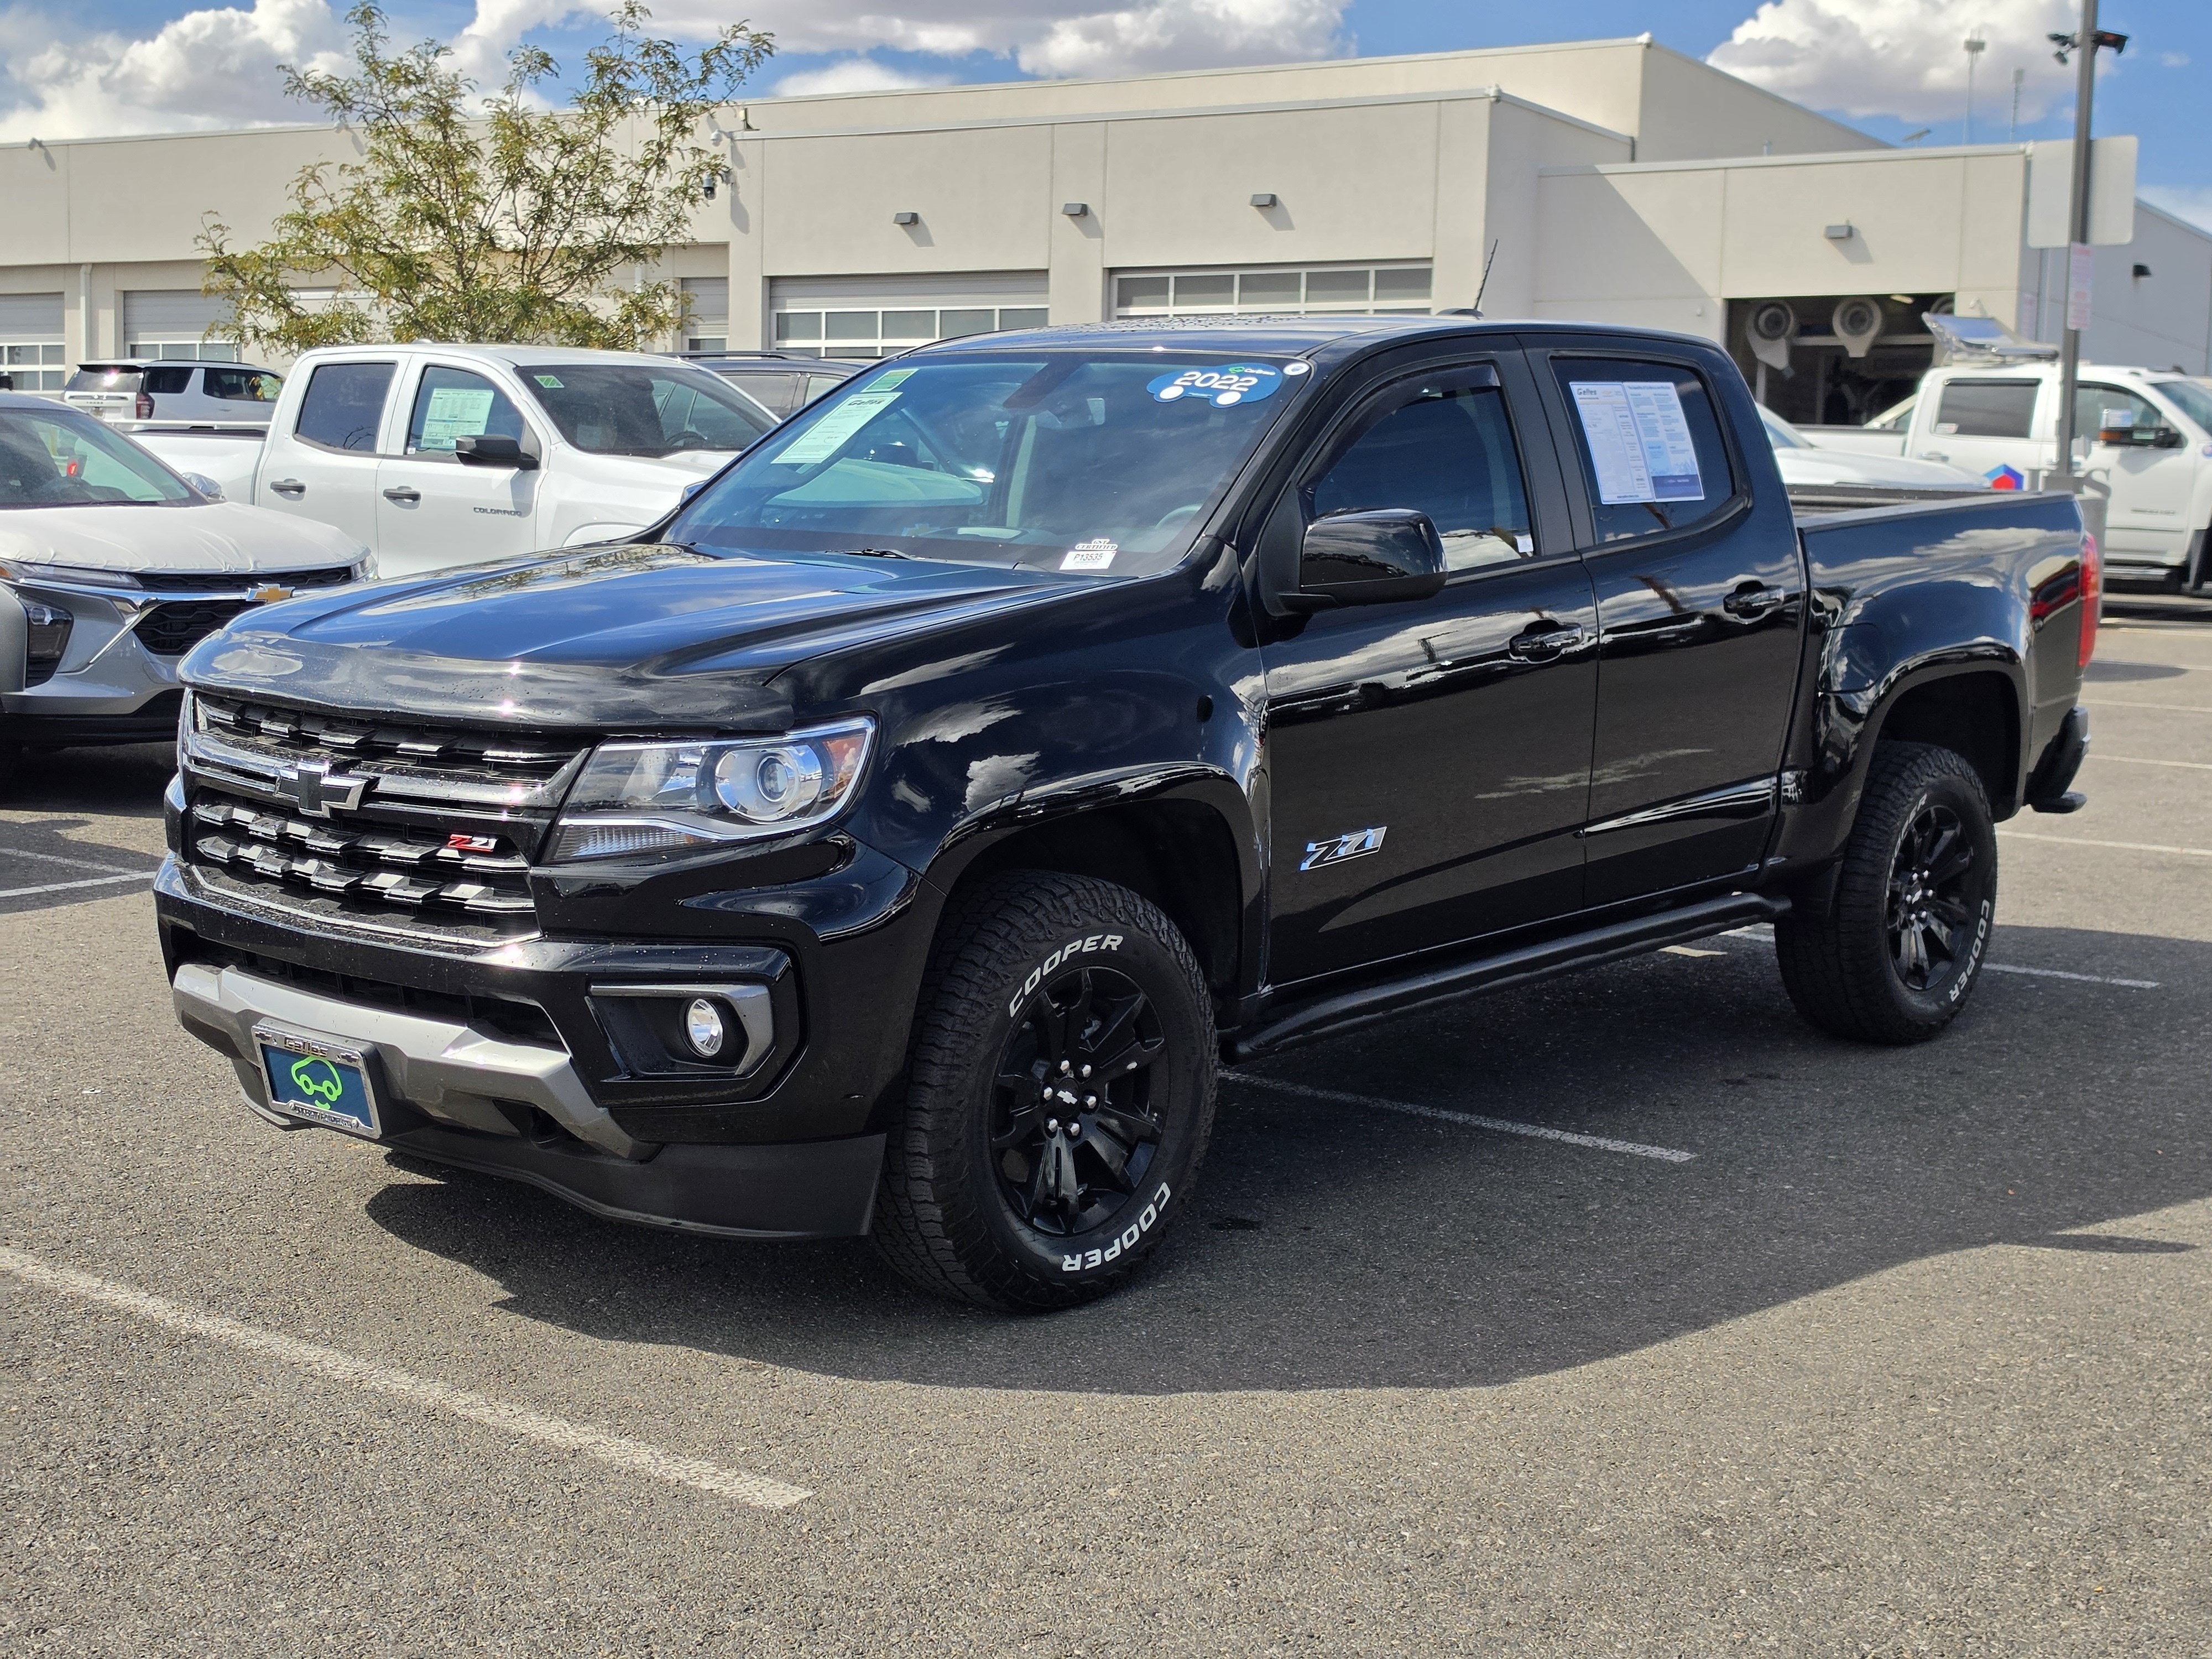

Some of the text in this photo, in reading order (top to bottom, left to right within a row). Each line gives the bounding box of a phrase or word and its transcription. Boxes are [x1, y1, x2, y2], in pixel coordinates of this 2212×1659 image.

[1173, 371, 1258, 392] 2022
[473, 507, 522, 516] COLORADO
[1073, 553, 1104, 561] P13535
[447, 833, 498, 852] Z71
[1300, 826, 1387, 871] Z71
[1949, 899, 1990, 1002] COOPER
[1009, 934, 1123, 1018] COOPER
[1061, 1181, 1171, 1272] COOPER
